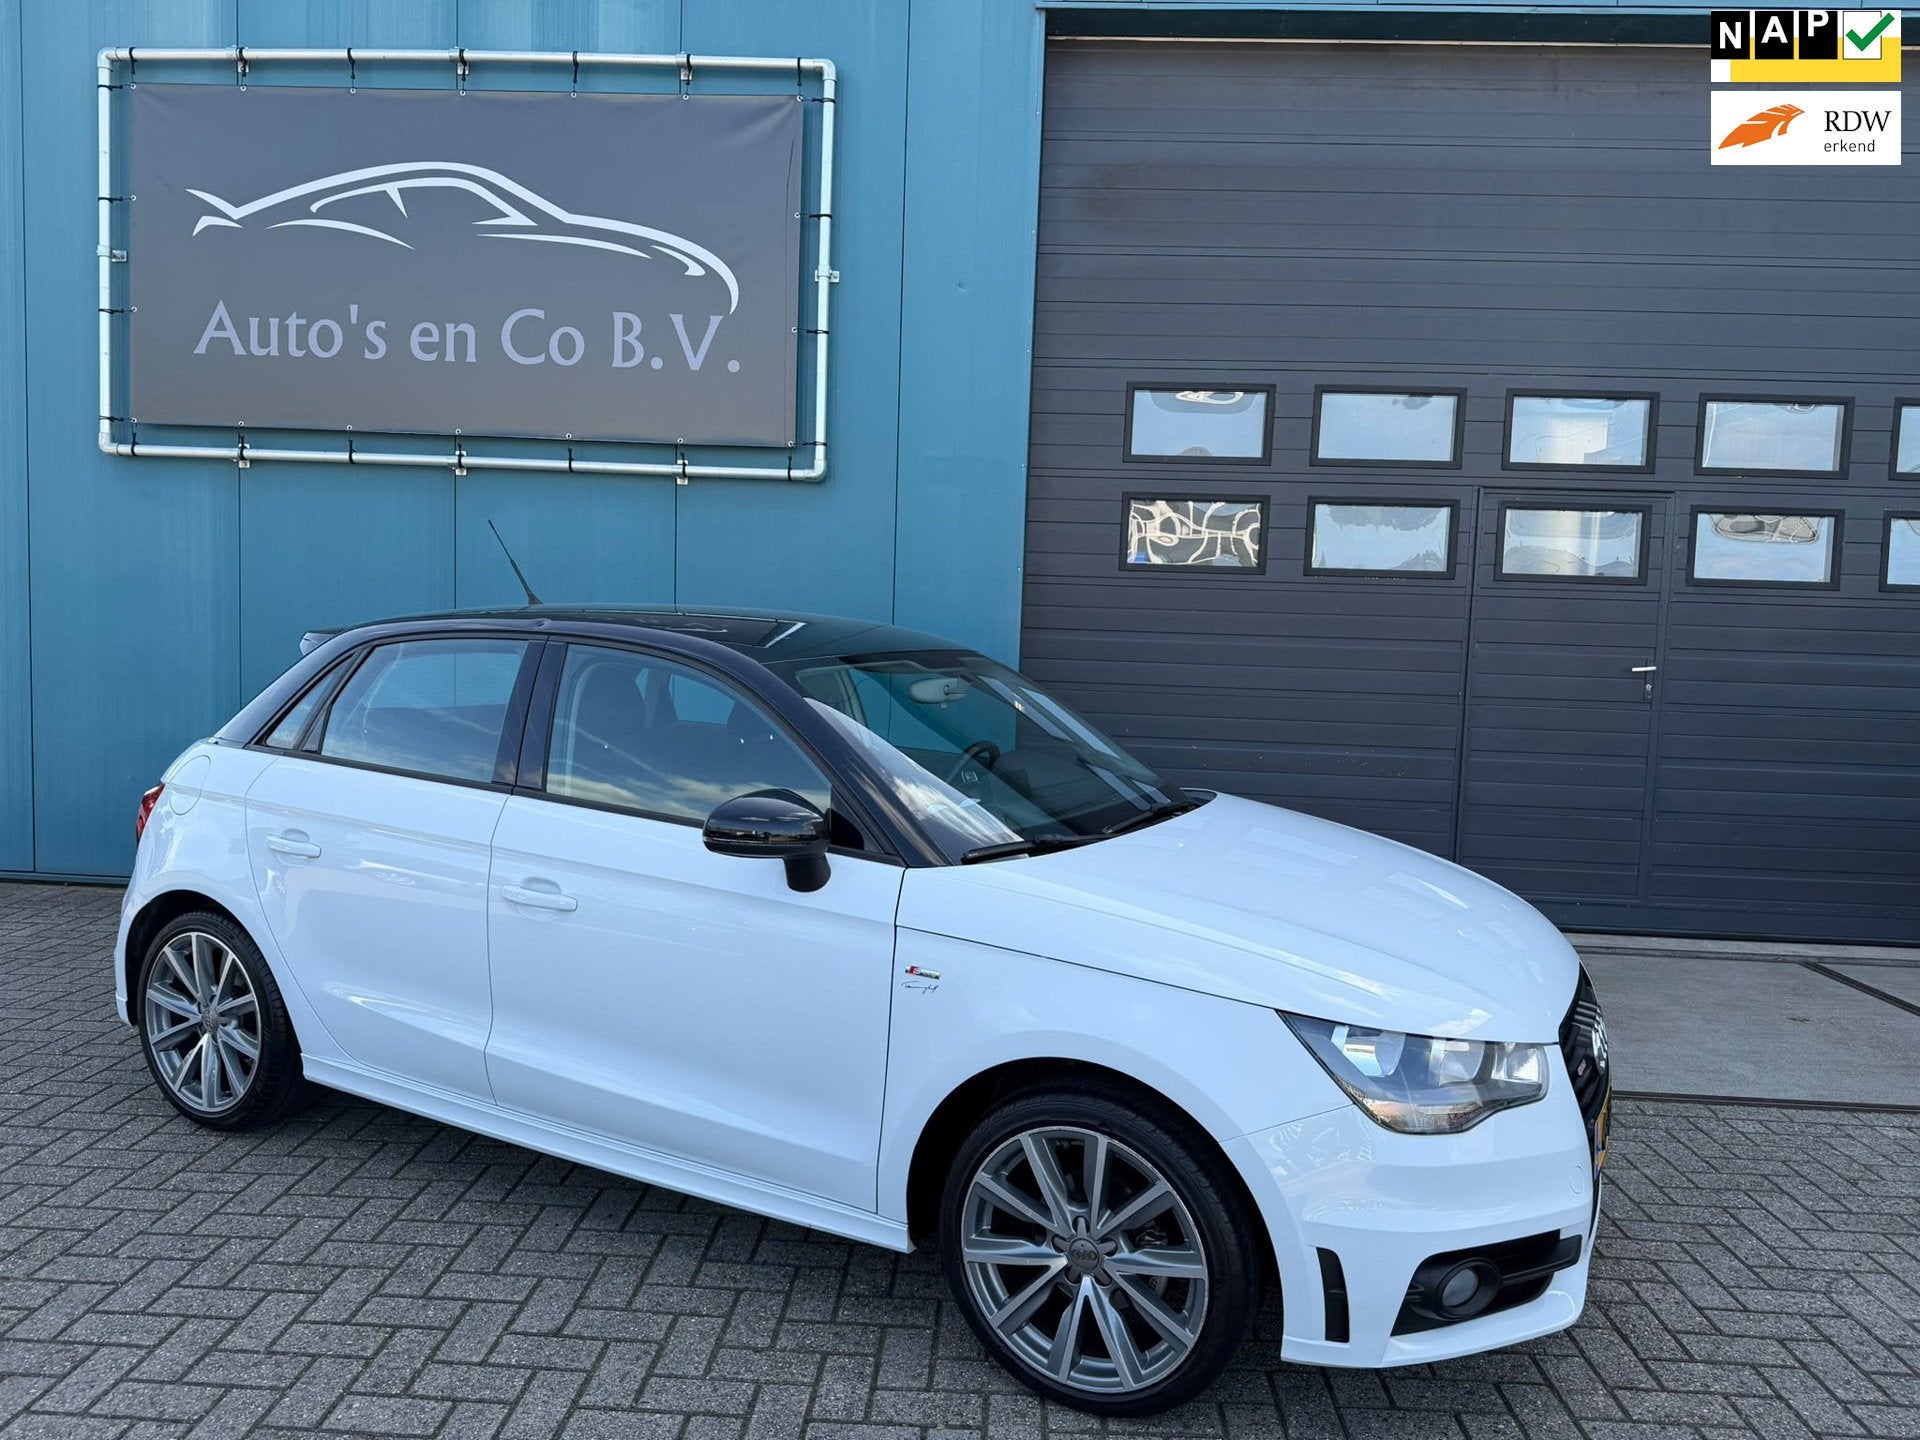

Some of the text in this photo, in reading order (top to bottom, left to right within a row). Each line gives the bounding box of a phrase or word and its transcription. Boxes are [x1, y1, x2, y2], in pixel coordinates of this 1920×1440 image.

[193, 299, 741, 373] Auto's en Co B.V.
